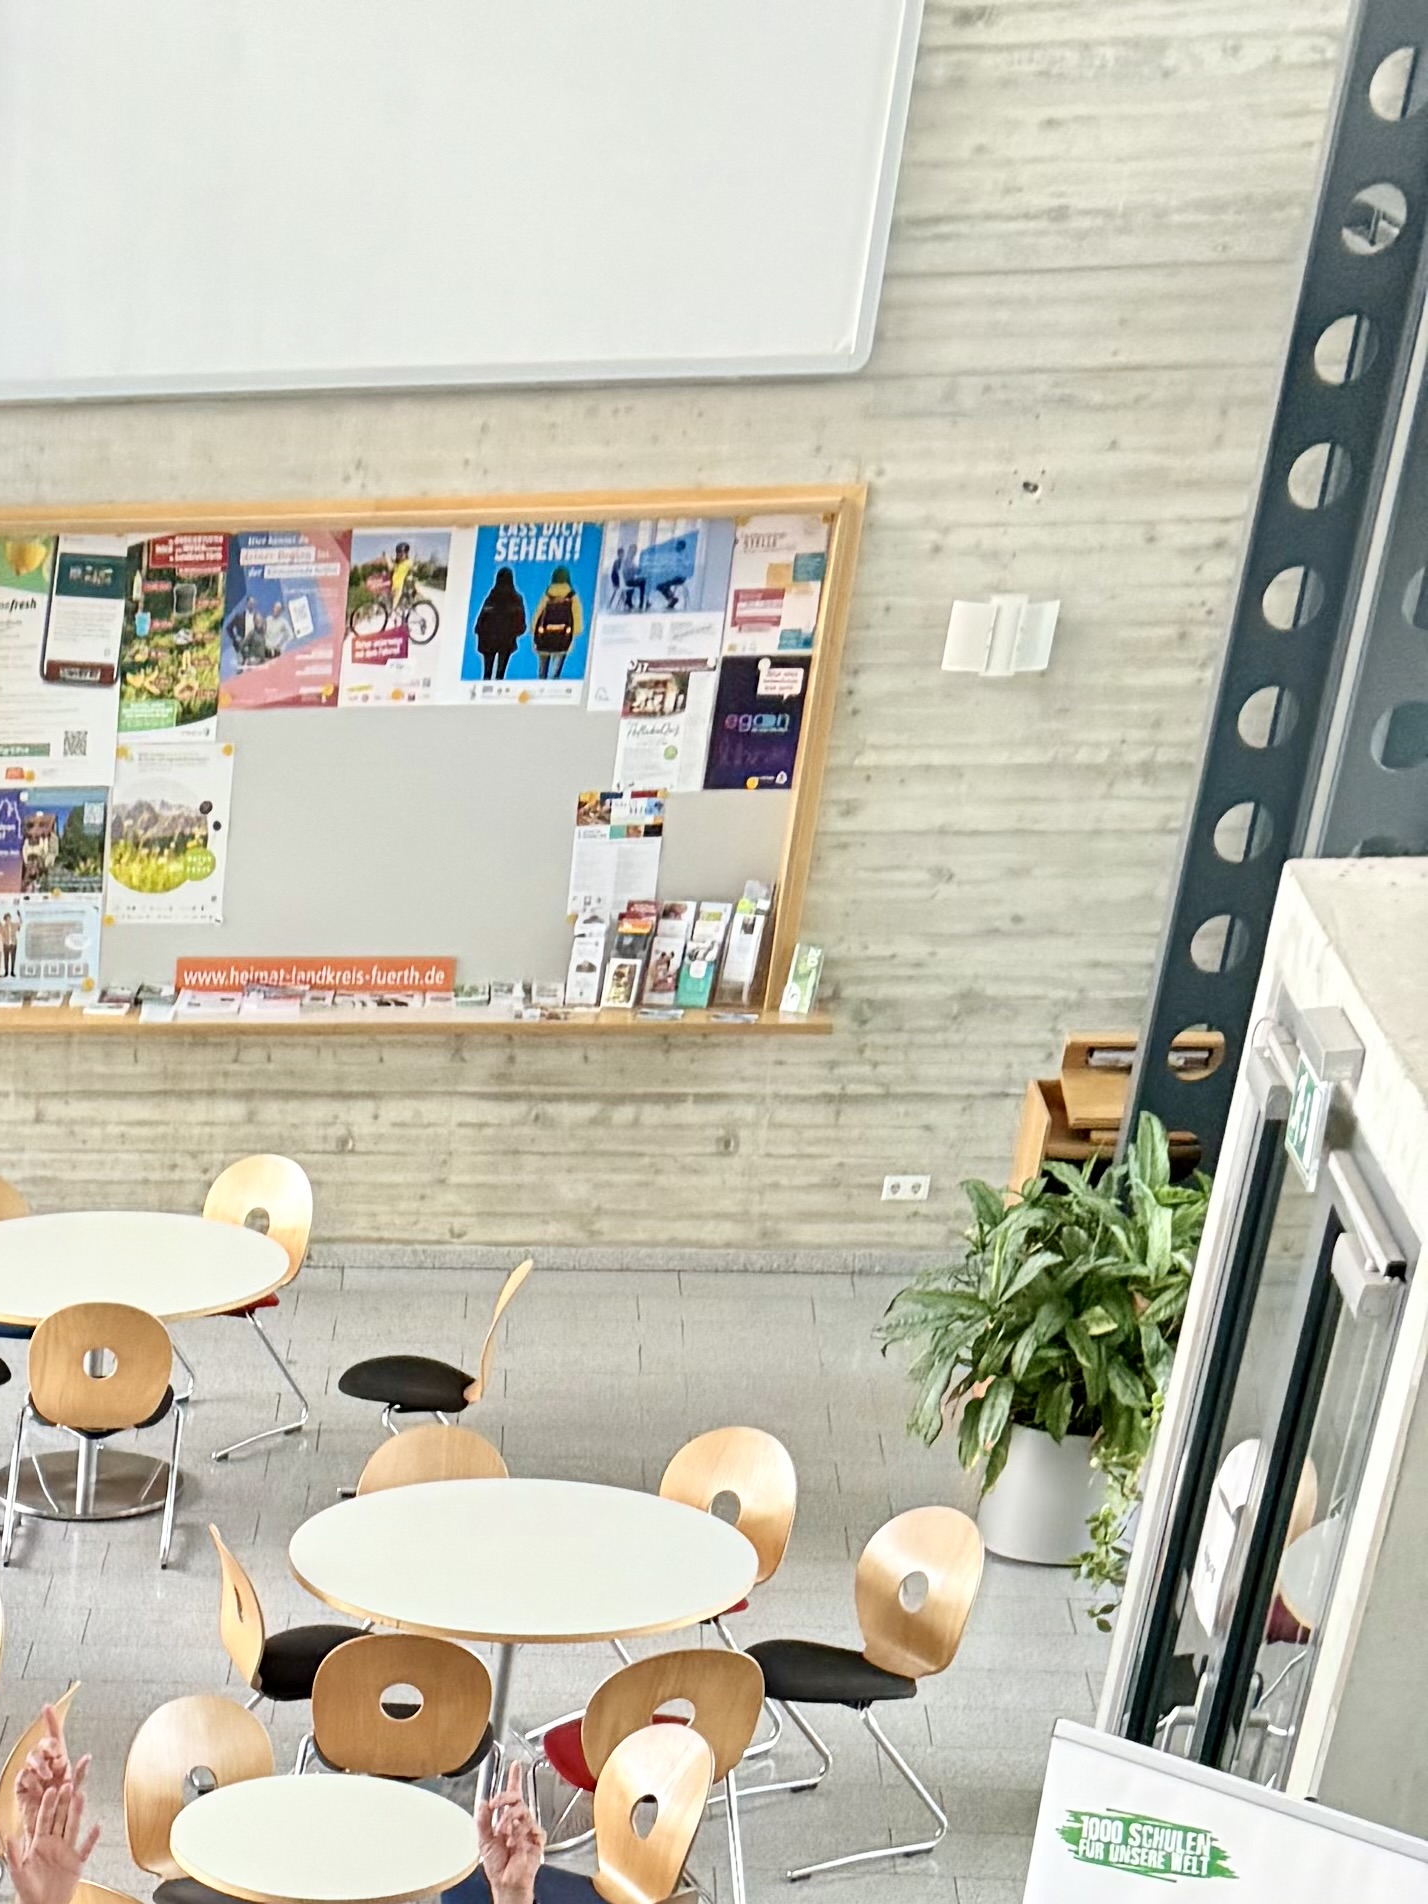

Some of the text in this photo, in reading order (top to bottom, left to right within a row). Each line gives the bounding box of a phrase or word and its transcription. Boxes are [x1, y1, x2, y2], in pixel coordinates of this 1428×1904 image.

[494, 536, 582, 562] SEHEN!!
[1080, 1815, 1212, 1856] 1000 SCHULEN
[1108, 1843, 1166, 1870] UNSERE
[1170, 1851, 1210, 1876] WELT
